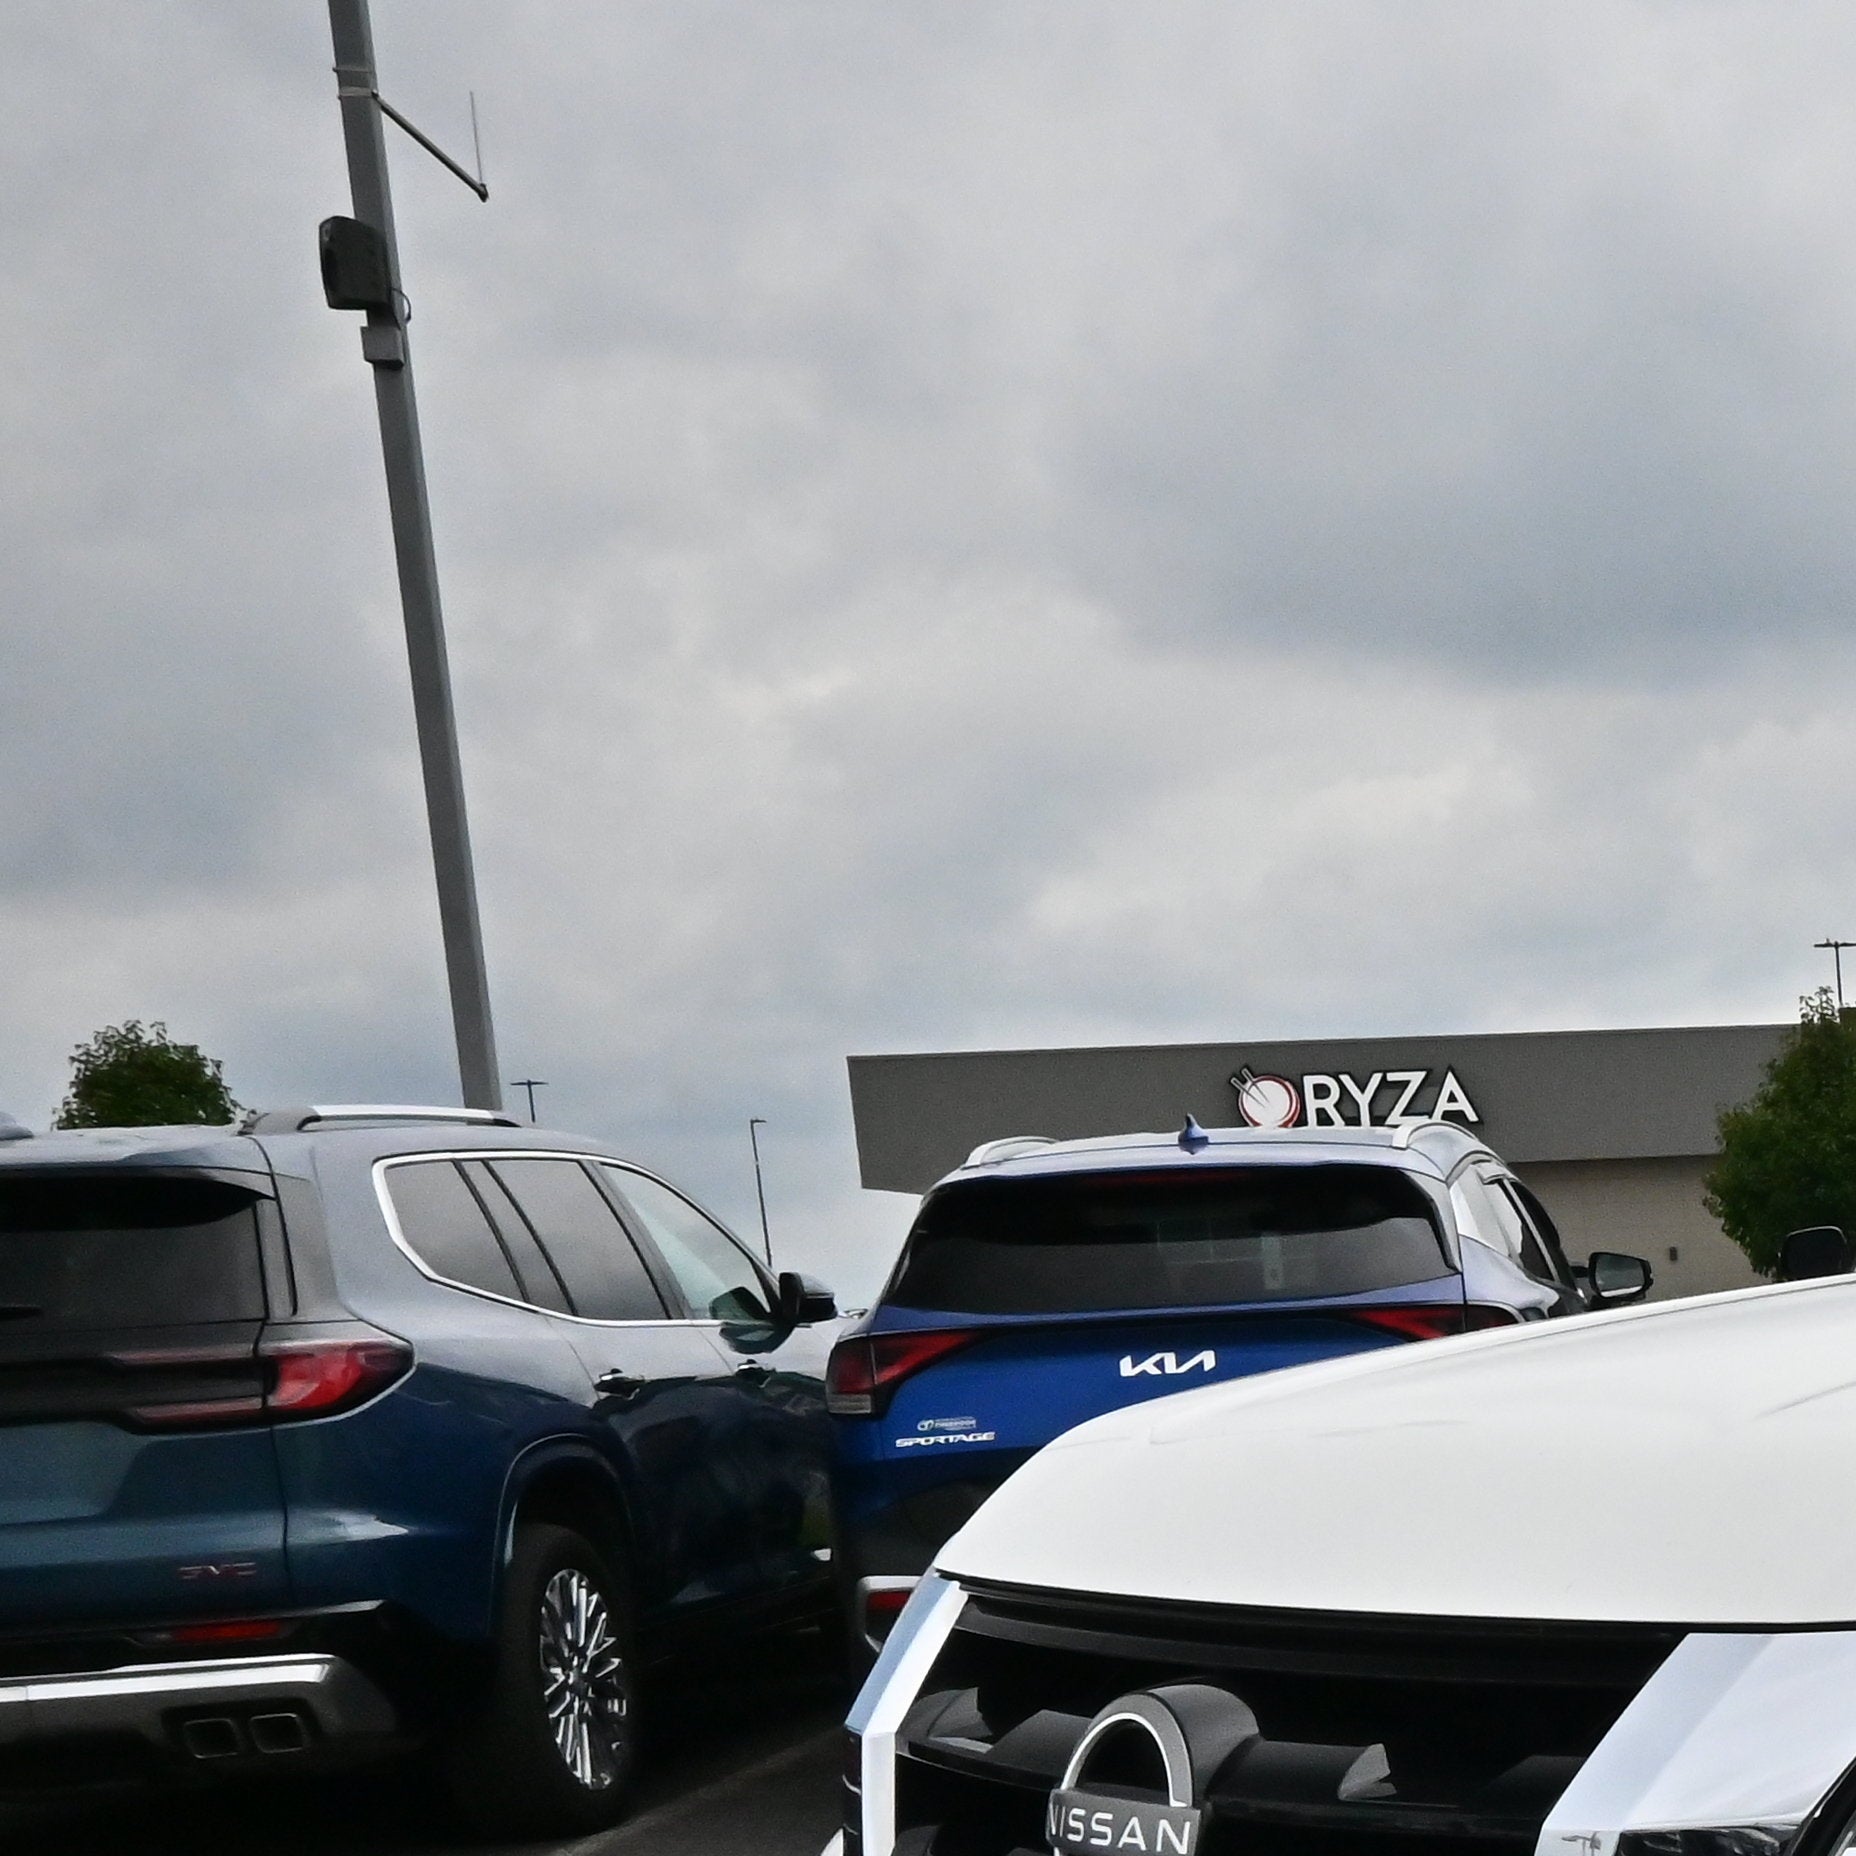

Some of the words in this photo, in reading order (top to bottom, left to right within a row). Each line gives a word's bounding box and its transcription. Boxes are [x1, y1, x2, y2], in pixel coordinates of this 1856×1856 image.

[1235, 1069, 1480, 1128] ORYZA
[1119, 1349, 1217, 1377] KIA
[895, 1431, 996, 1448] SPORTAGE
[1049, 1800, 1191, 1855] NISSAN
